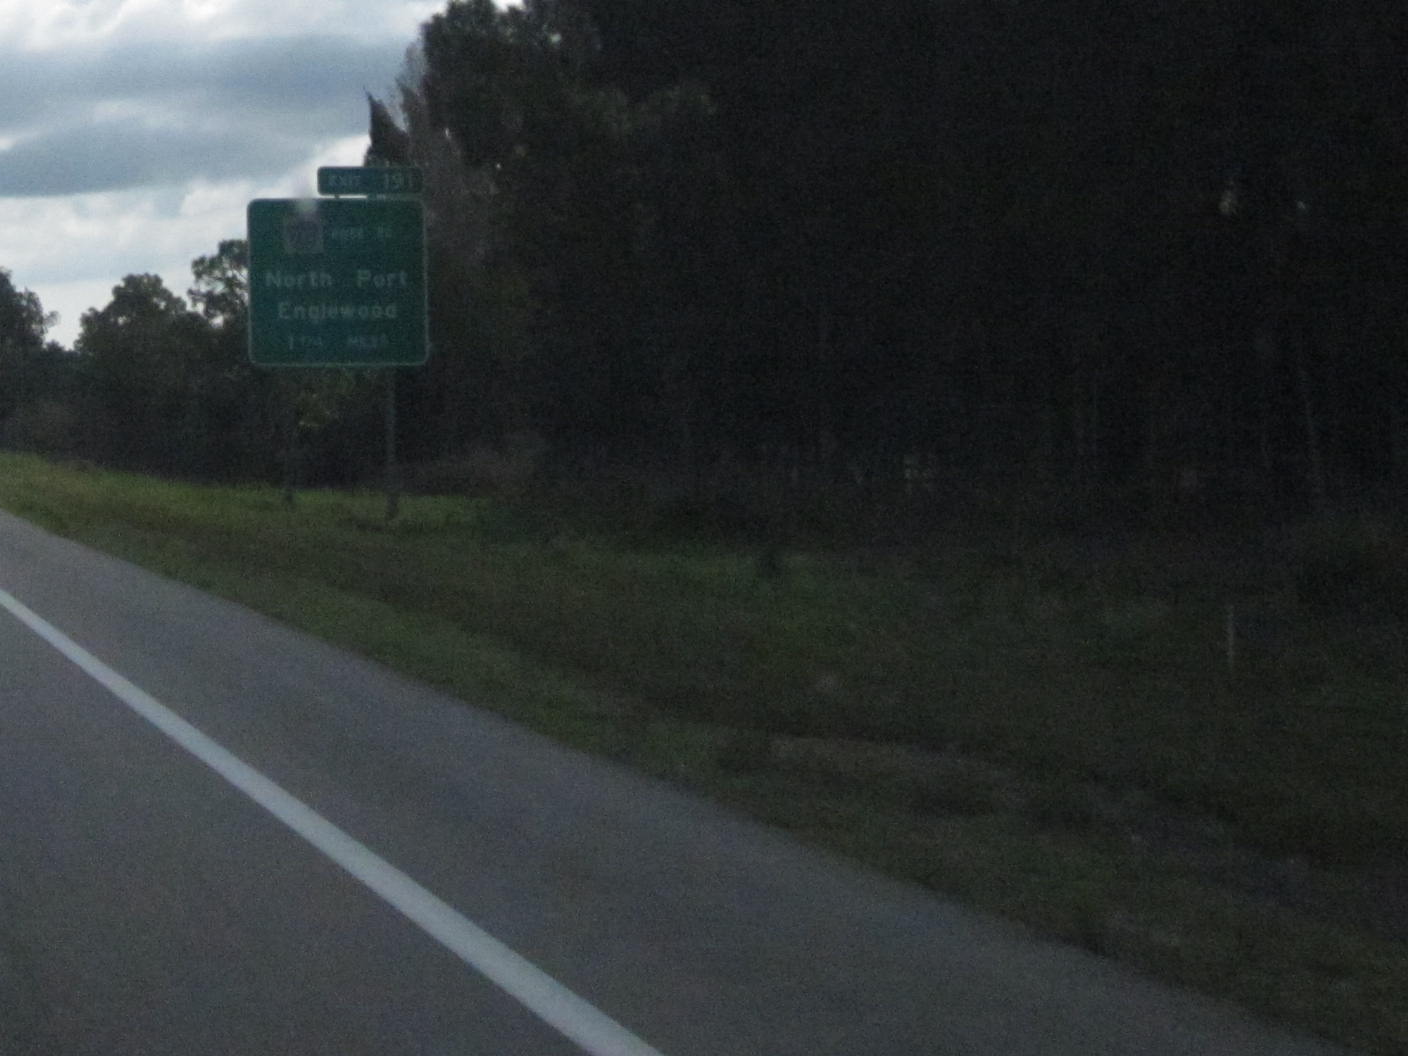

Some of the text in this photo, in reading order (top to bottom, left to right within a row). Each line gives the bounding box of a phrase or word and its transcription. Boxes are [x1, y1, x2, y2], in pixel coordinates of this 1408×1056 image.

[265, 269, 408, 289] North Port
[278, 300, 398, 324] Englewood
